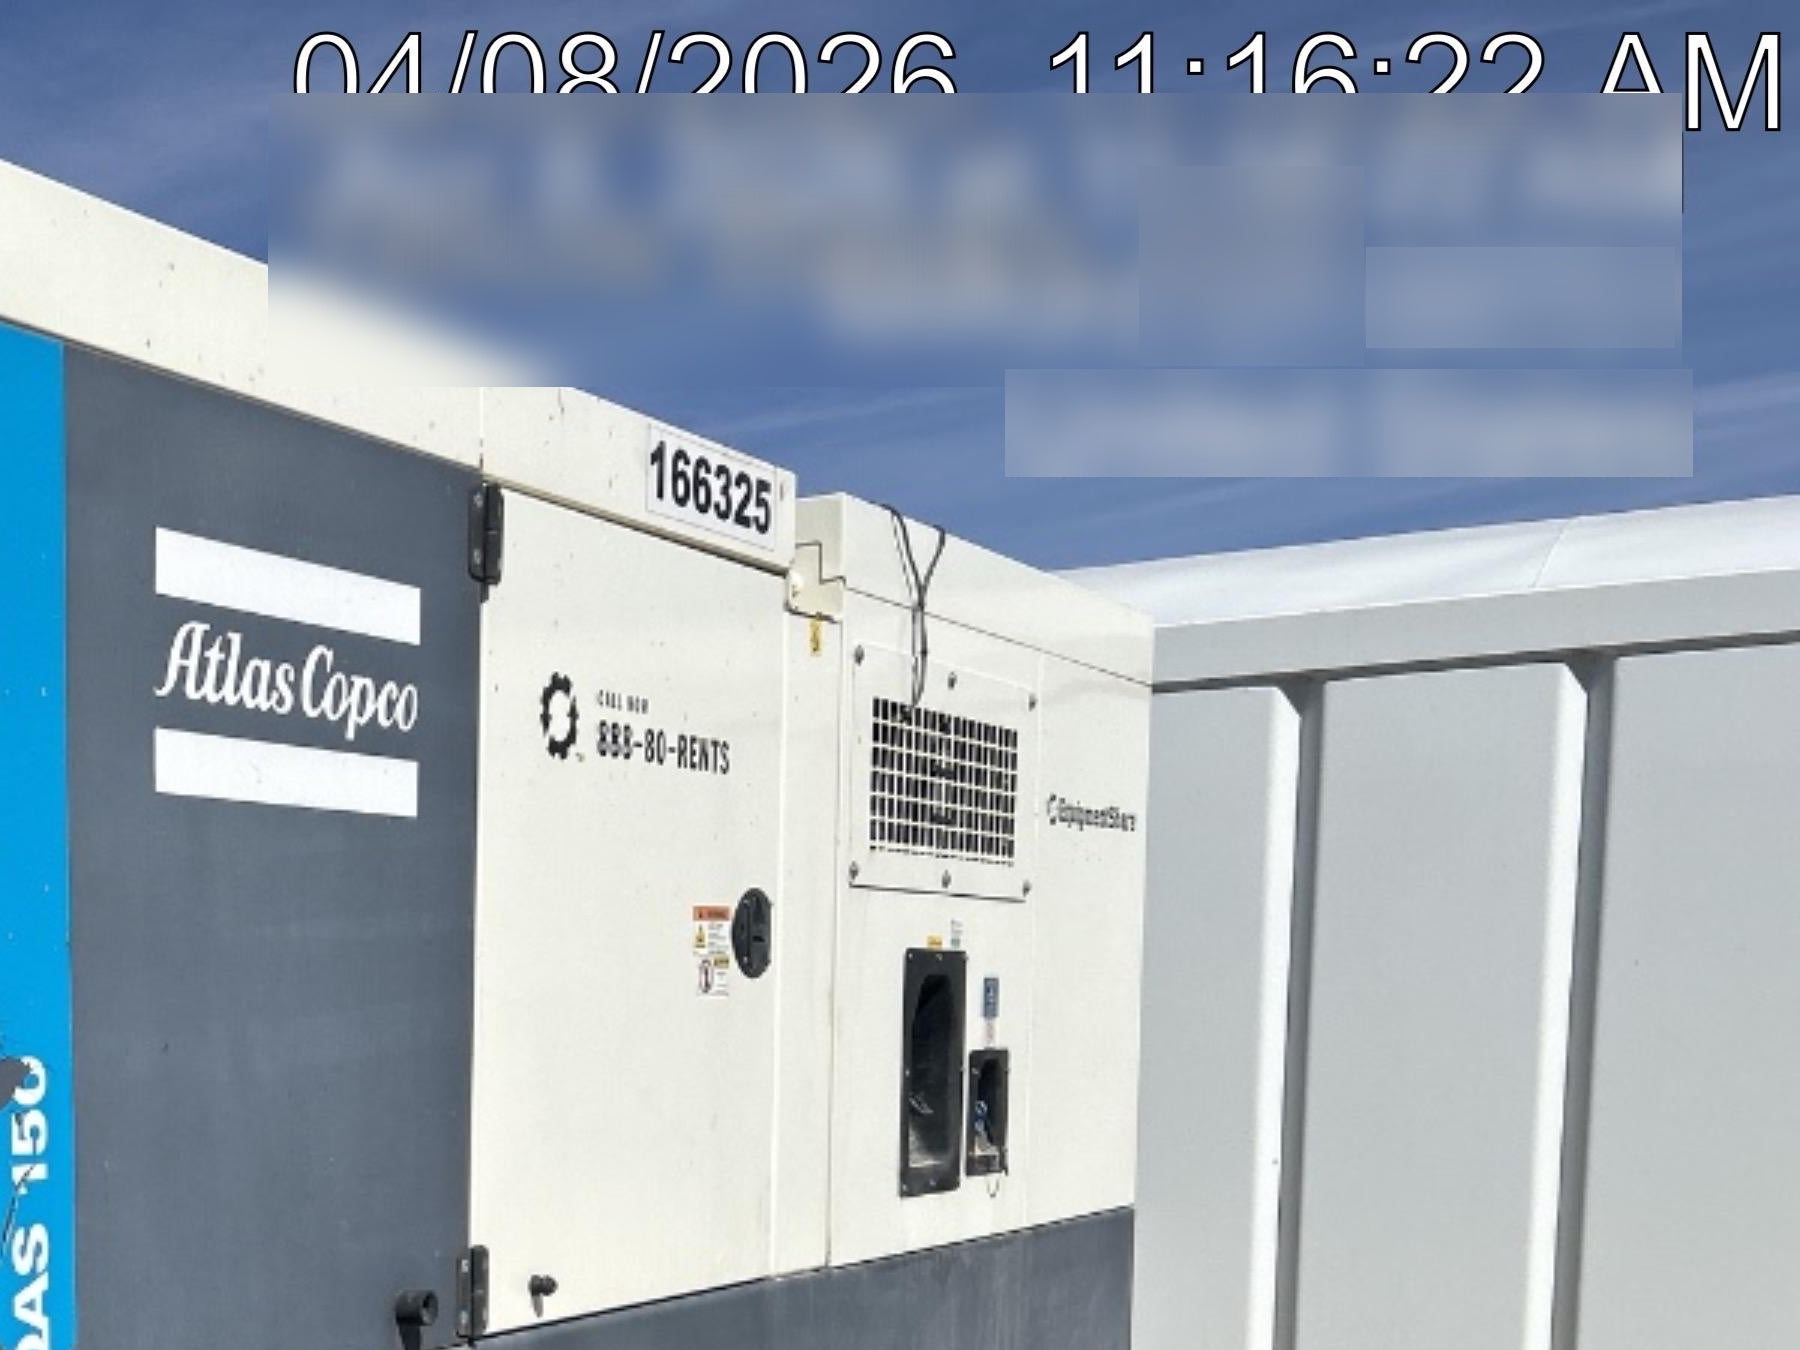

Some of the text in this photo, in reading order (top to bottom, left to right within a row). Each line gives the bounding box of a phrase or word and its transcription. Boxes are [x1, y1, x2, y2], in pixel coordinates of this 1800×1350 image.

[650, 440, 772, 534] 166325
[153, 620, 418, 741] Atlas Copco
[597, 689, 649, 714] CALL NOW
[597, 720, 730, 774] 888-80-RENTS
